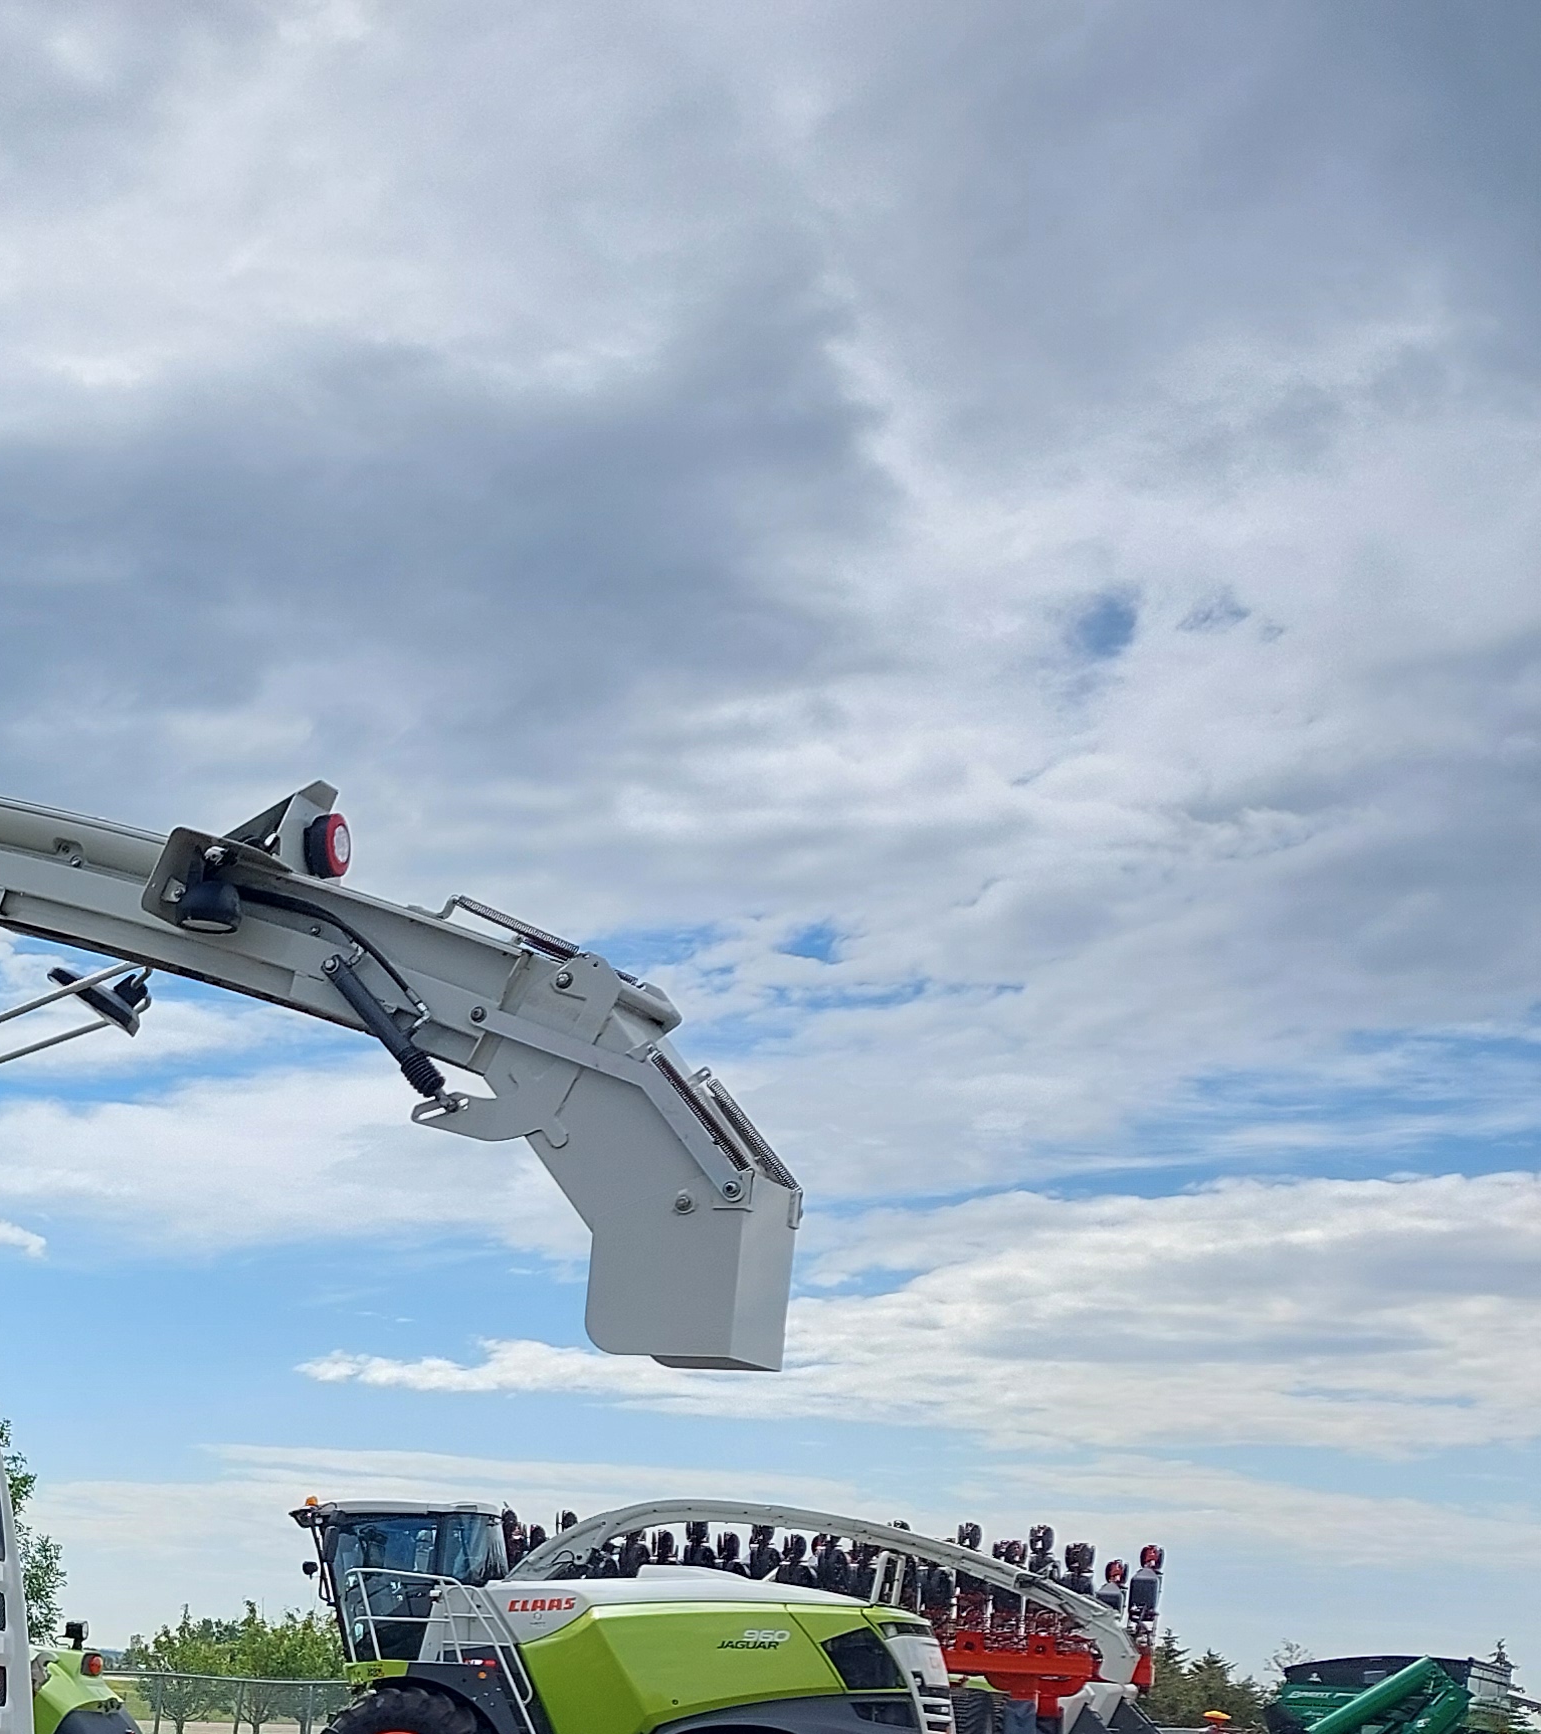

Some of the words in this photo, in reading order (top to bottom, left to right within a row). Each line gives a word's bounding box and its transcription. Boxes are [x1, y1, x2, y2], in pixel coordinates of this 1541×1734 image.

[508, 1596, 577, 1613] CLAAS
[743, 1629, 790, 1642] 960
[717, 1640, 779, 1650] JAGUAR
